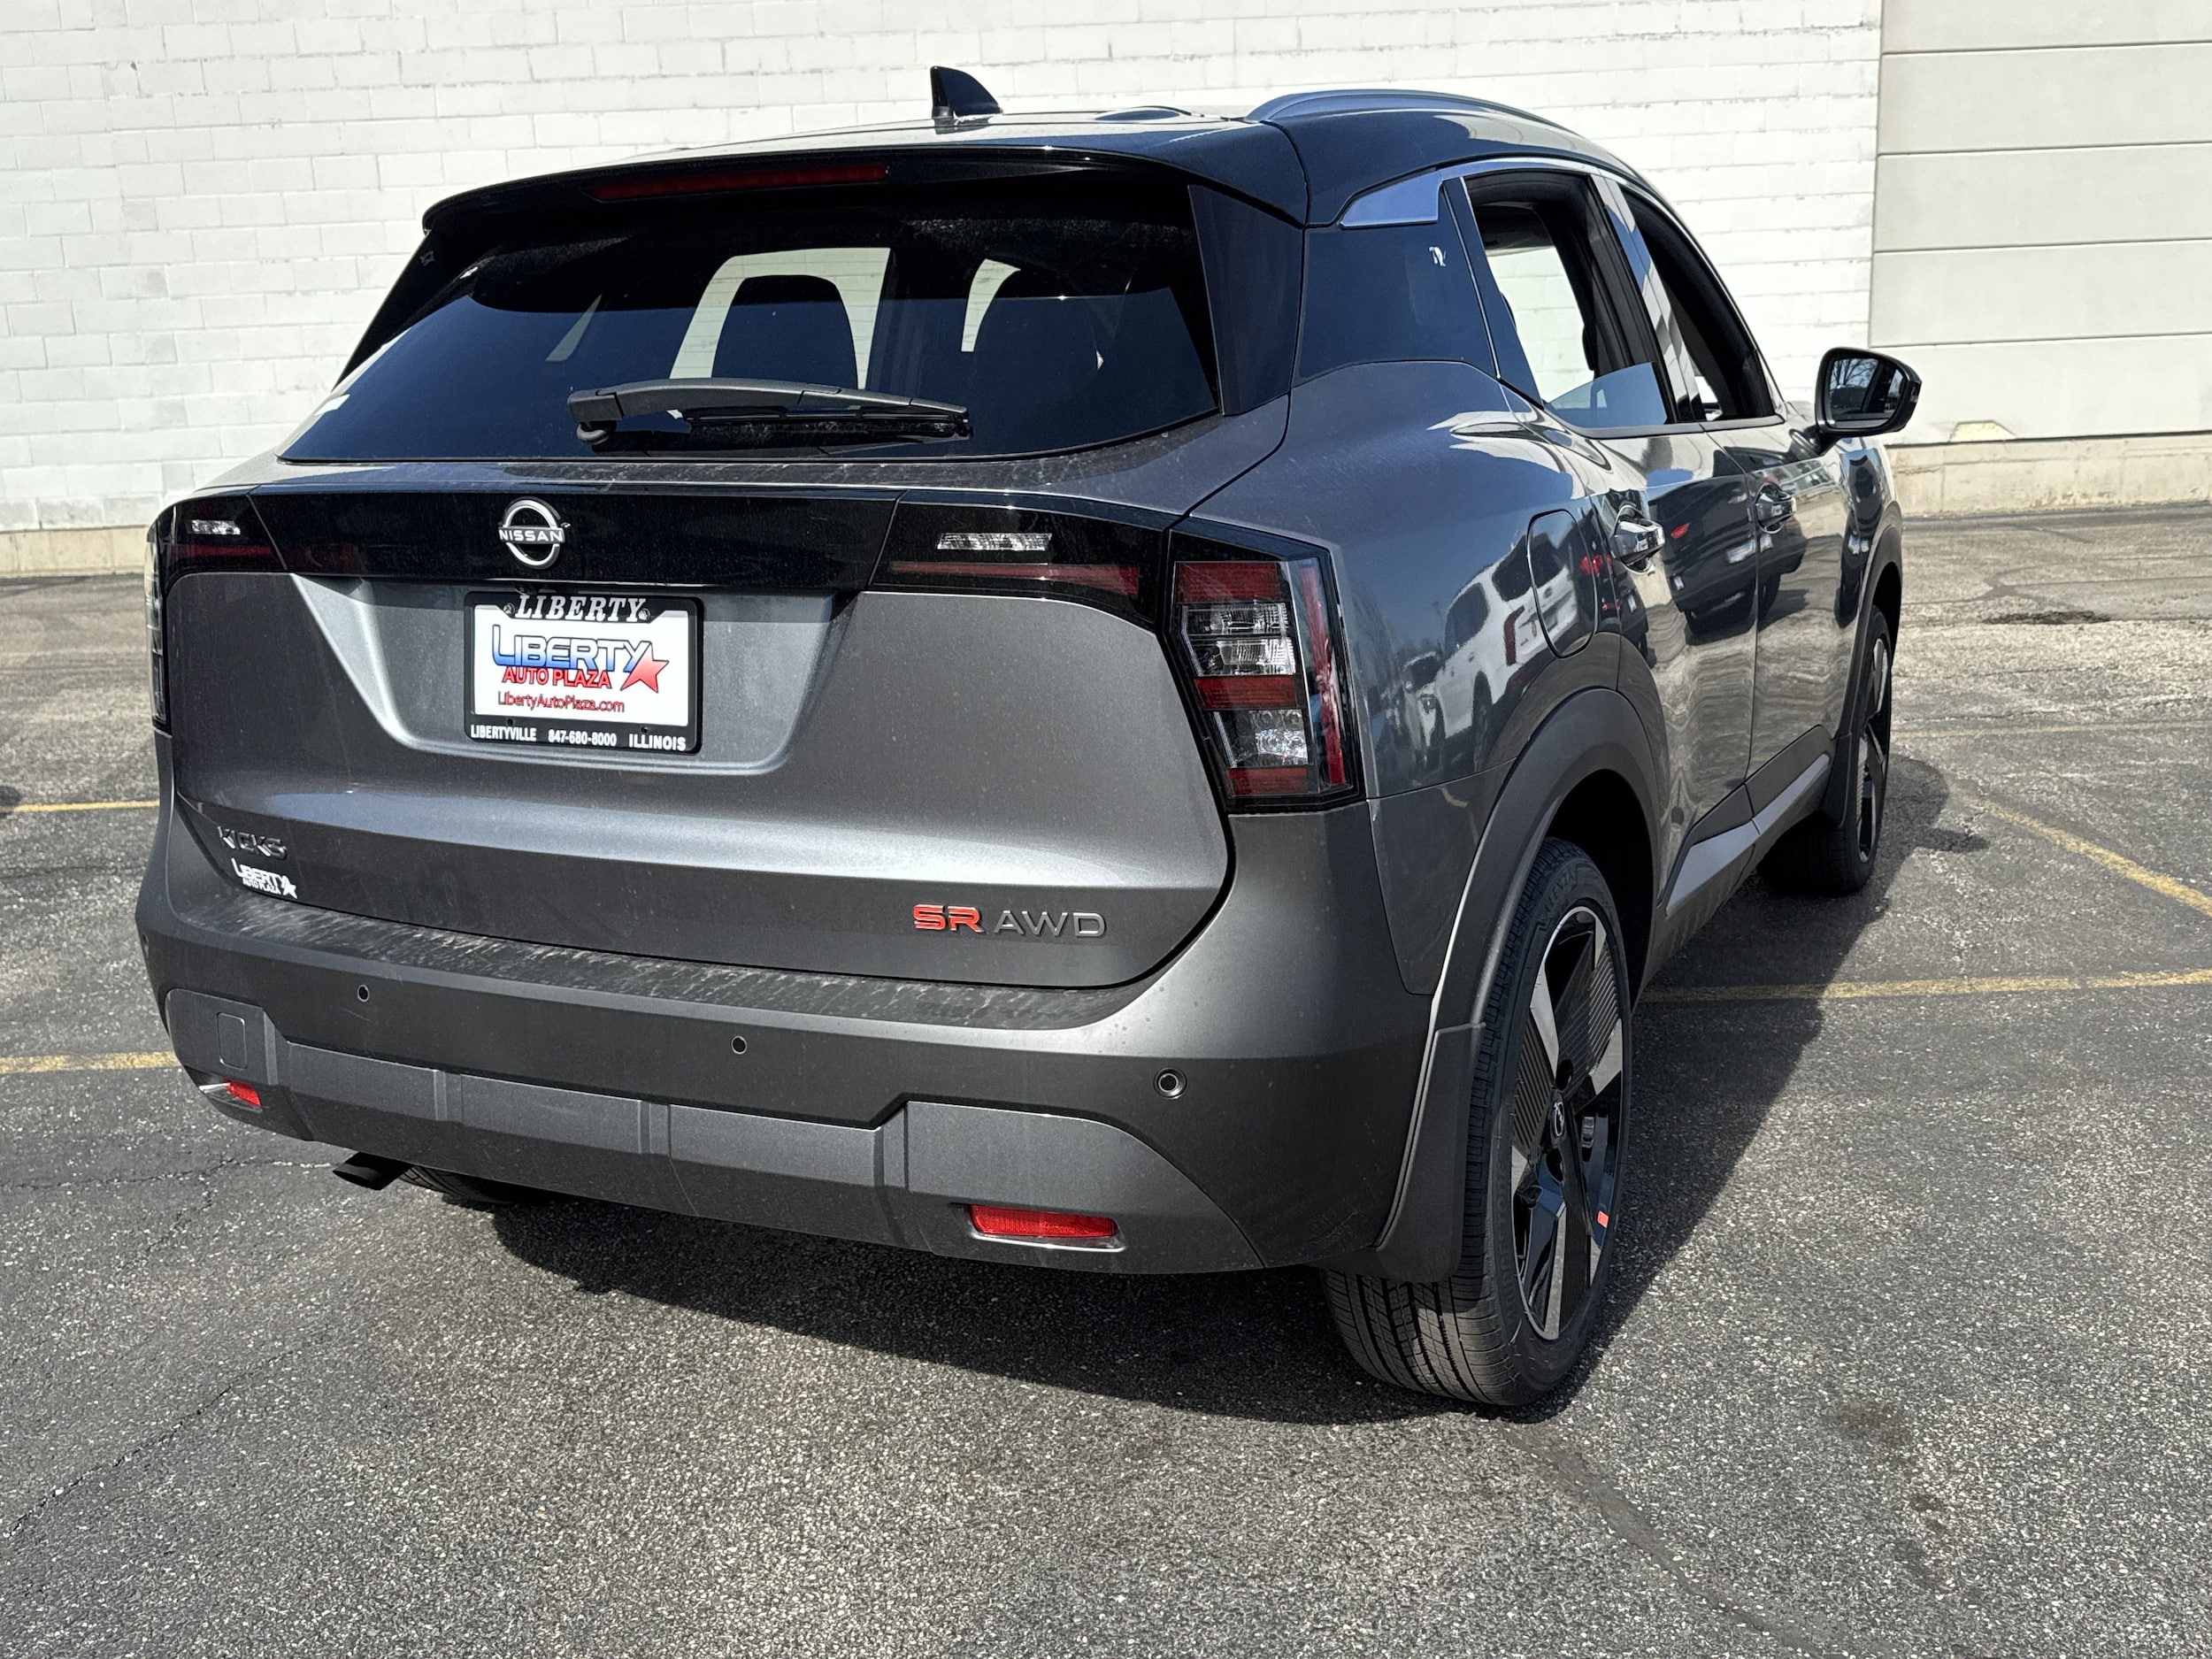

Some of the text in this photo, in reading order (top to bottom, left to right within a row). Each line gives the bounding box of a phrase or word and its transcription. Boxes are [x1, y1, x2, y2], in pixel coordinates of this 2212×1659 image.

[498, 529, 564, 542] NISSAN
[514, 595, 647, 623] LIBERTY
[492, 624, 652, 672] LIBERTY
[502, 666, 612, 689] AUTO PLAZA
[497, 691, 625, 712] LibertyAutoPlaza.com
[471, 725, 687, 751] LIBERTYVILLE 847-680-8000 ILLINOIS
[231, 857, 289, 889] LIBERTY
[912, 903, 1105, 937] SR AWD
